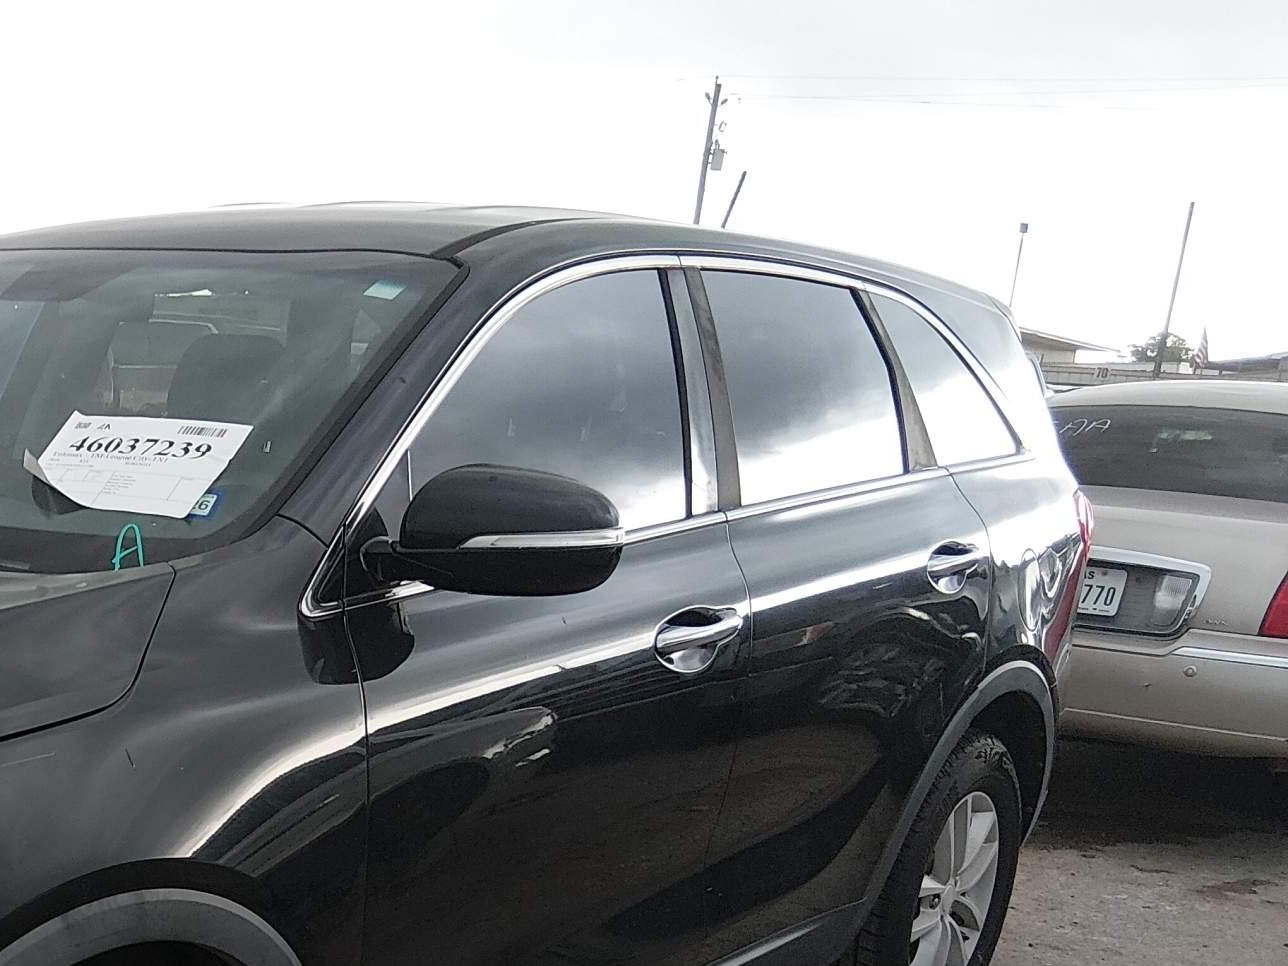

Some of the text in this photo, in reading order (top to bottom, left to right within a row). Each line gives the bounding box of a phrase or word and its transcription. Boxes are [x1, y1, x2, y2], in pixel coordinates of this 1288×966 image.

[69, 435, 213, 460] 46037239
[112, 523, 144, 571] A
[1081, 584, 1117, 607] 770
